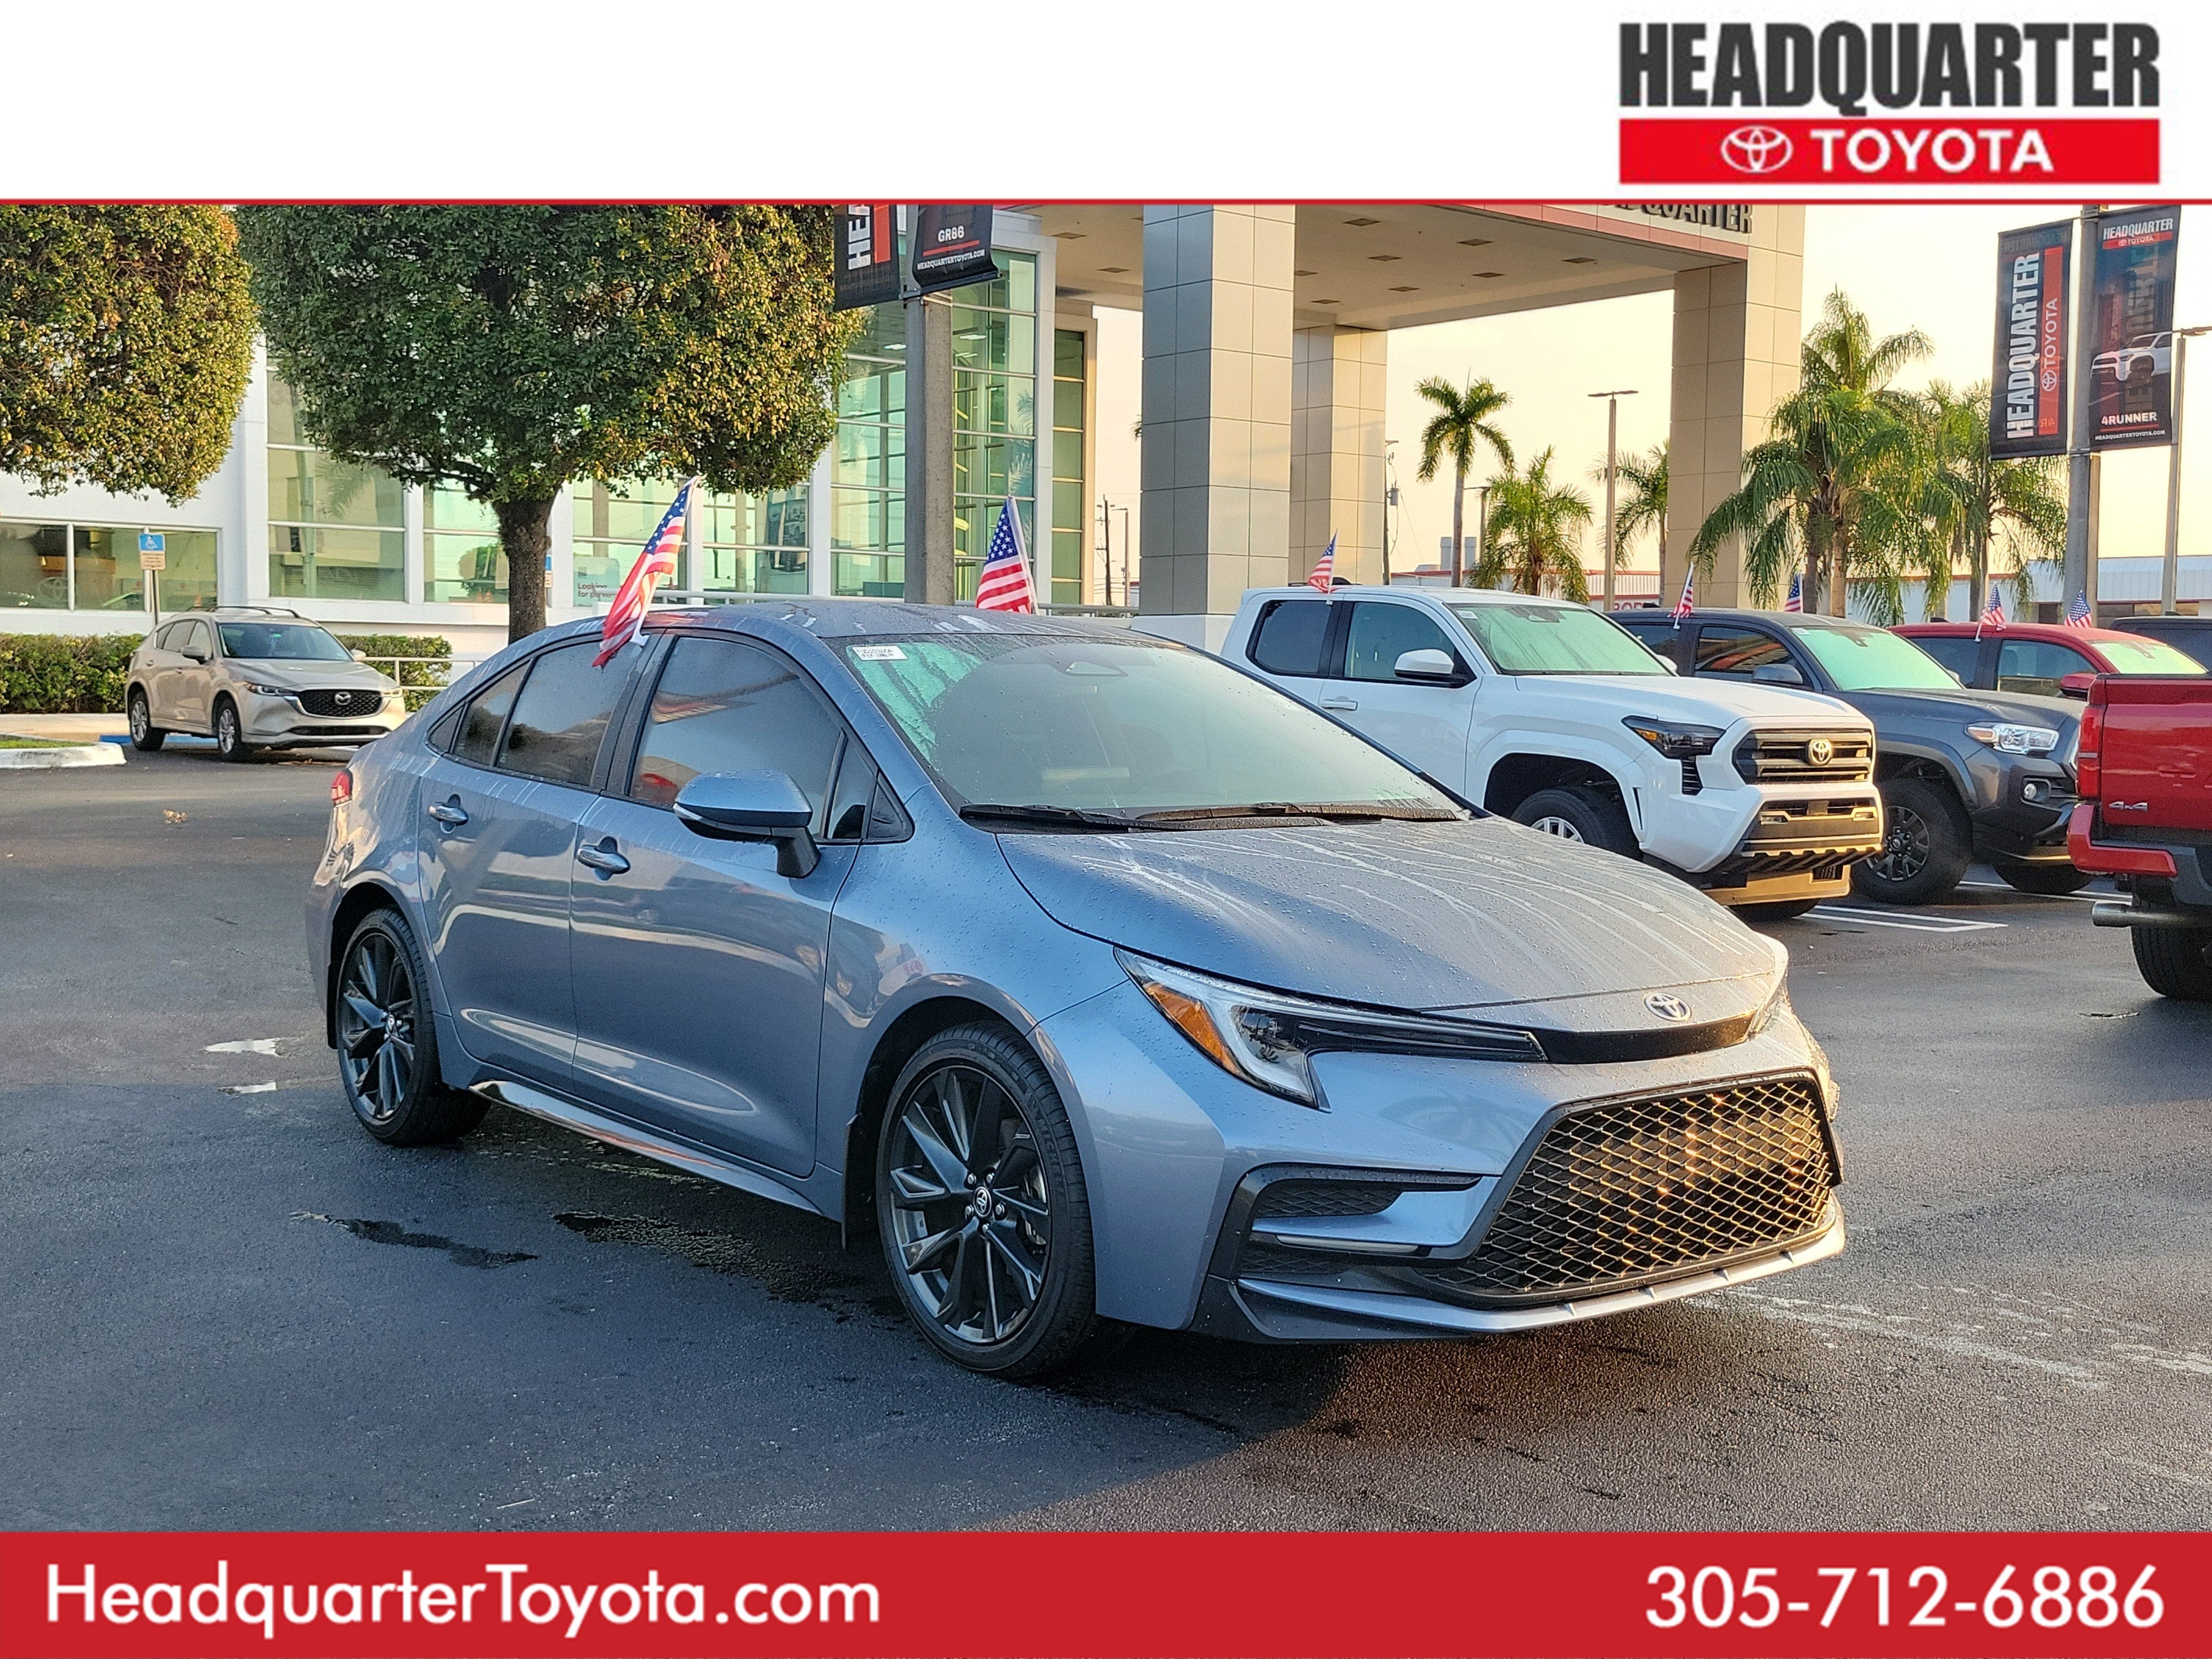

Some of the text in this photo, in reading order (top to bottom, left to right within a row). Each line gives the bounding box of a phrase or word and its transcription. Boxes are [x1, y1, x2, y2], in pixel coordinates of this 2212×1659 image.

[938, 225, 964, 242] GR86
[2103, 218, 2174, 240] HEADQUARTER
[2128, 235, 2154, 245] TOYOTA
[917, 249, 985, 270] HEADQUARTERTOYOTA.COM
[2044, 297, 2057, 369] TOYOTA
[2007, 252, 2040, 438] HEADQUARTER
[2101, 411, 2157, 426] 4RUNNER
[2095, 430, 2166, 441] HEADQUARTERTOYOTA.COM
